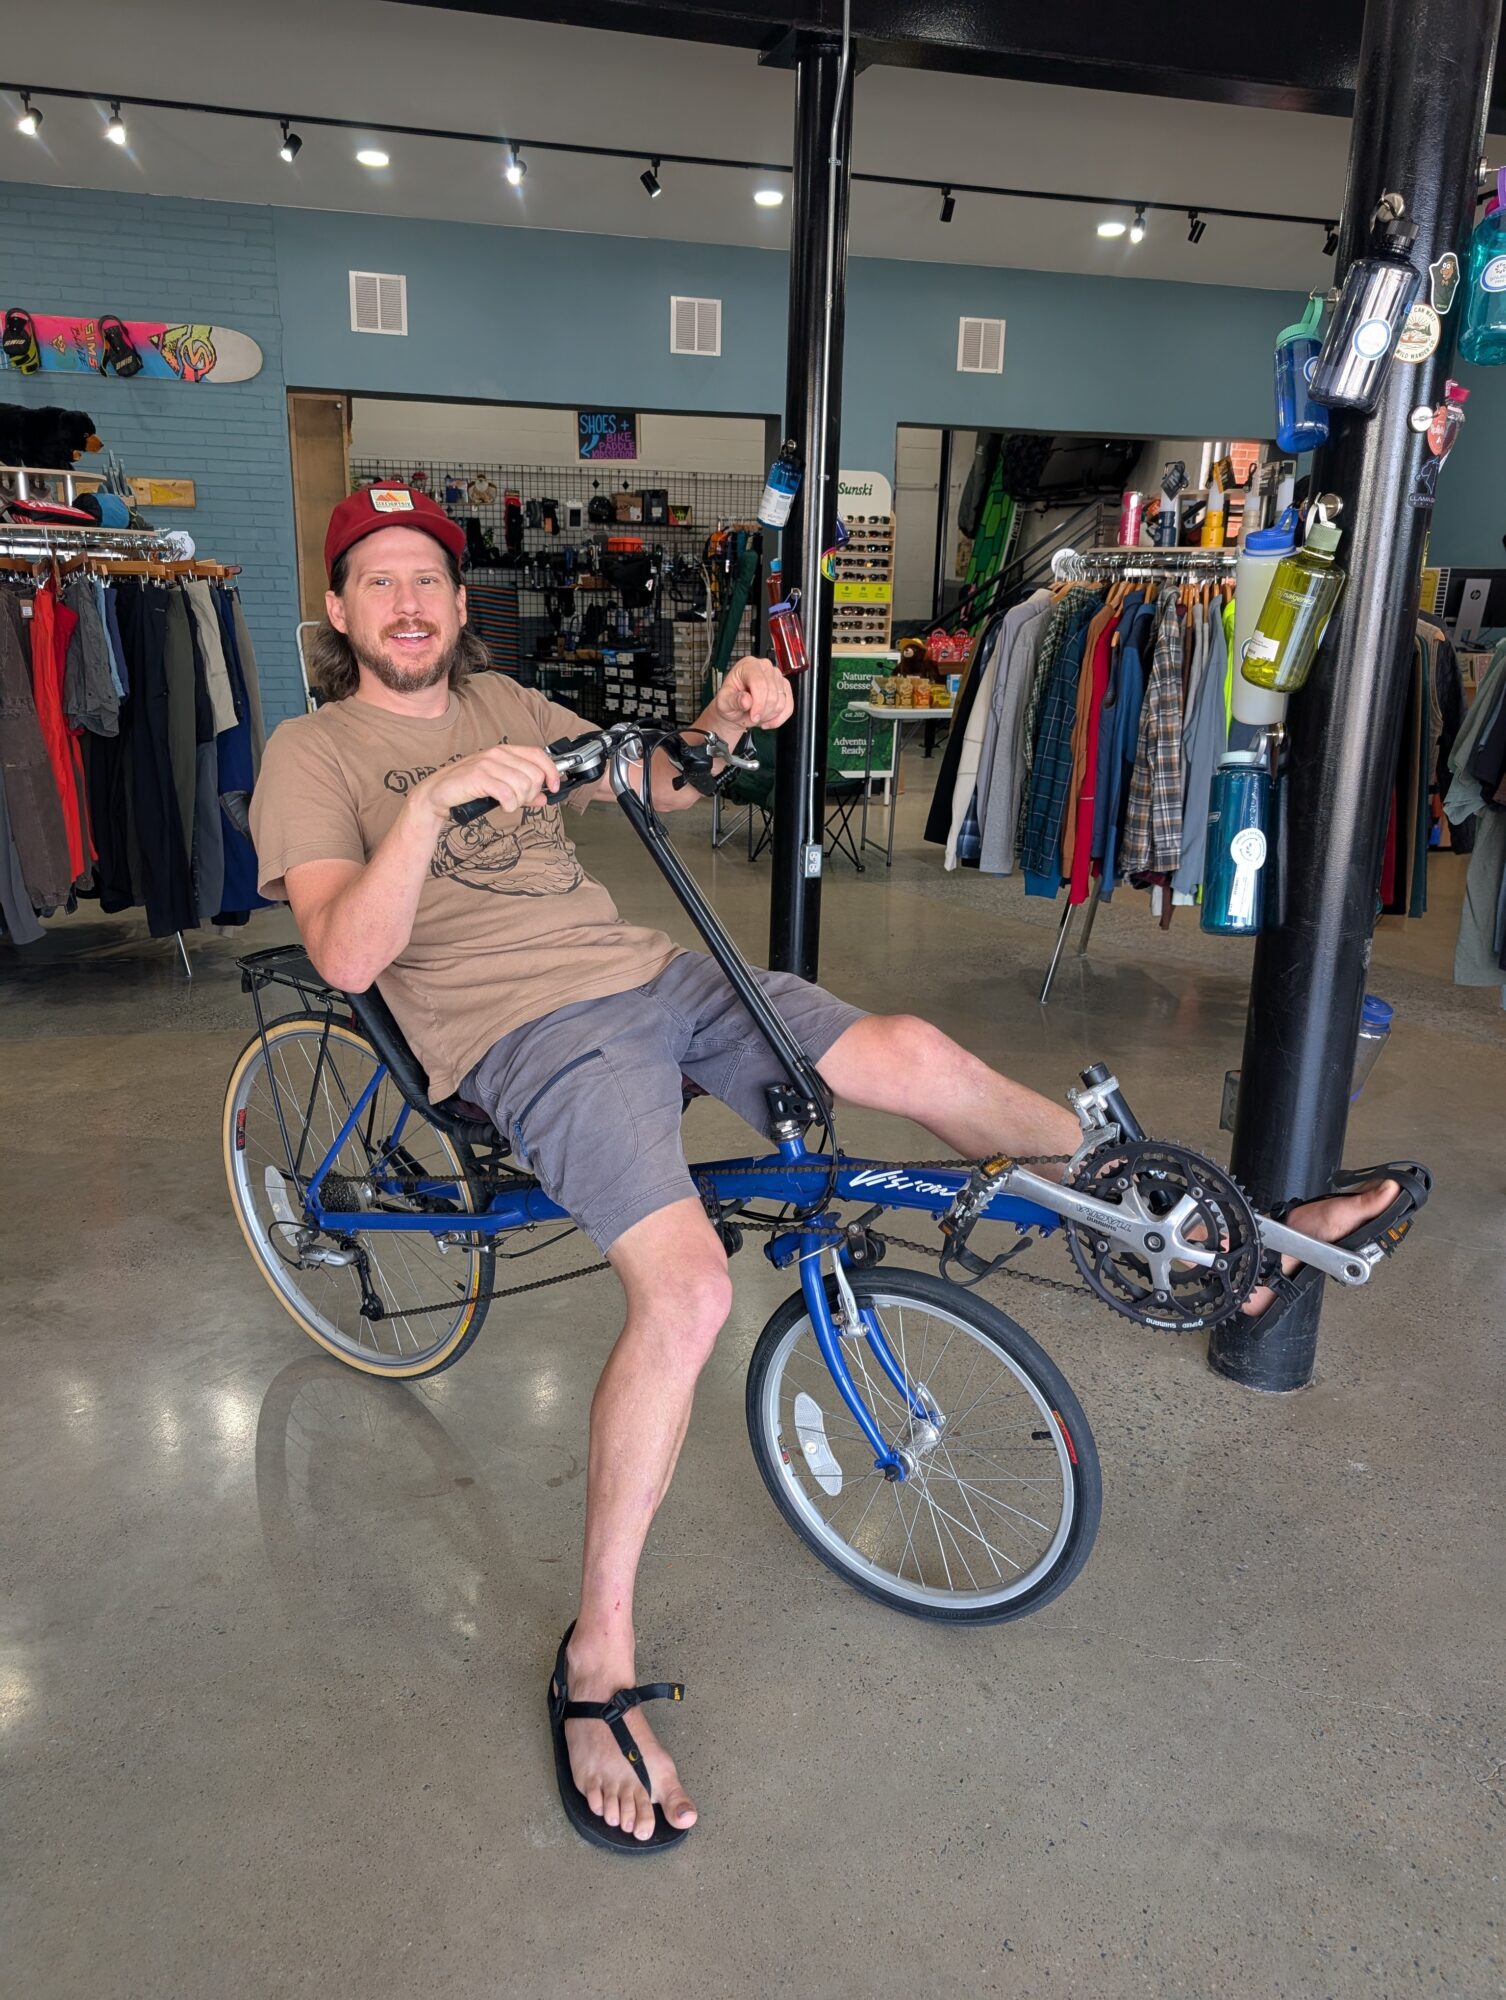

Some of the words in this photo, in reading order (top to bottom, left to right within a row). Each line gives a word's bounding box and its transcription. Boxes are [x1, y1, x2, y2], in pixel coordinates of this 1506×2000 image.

[85, 321, 98, 370] SIMS
[580, 414, 617, 434] SHOES
[606, 432, 632, 443] BIKE
[599, 441, 635, 452] PADDLE
[838, 482, 873, 496] Sunski
[842, 672, 872, 681] Nature
[836, 681, 871, 690] Obsesse
[833, 737, 875, 746] Adventue
[841, 746, 867, 757] Ready
[849, 1168, 957, 1197] Vision
[1145, 1317, 1177, 1329] SHIMANO
